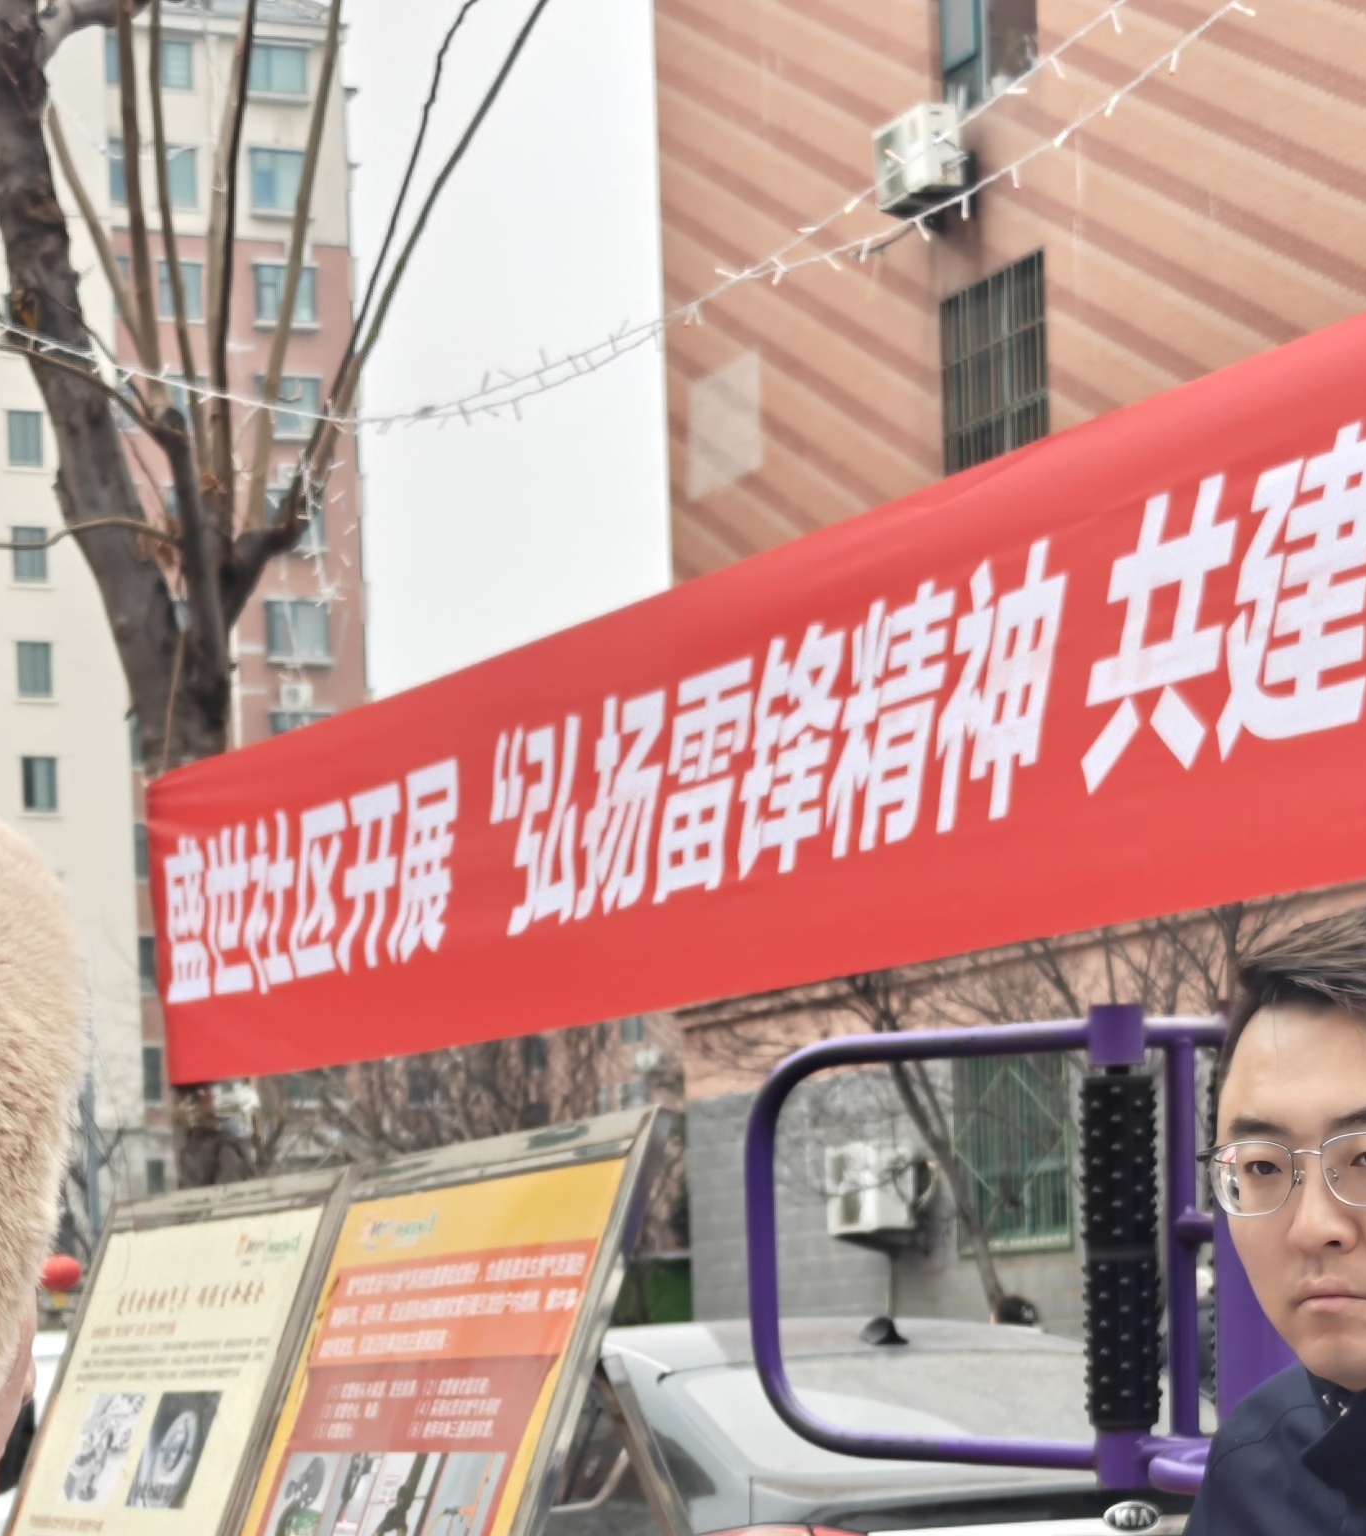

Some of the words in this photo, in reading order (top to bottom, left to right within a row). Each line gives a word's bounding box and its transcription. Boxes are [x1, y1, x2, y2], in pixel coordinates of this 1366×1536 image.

[164, 757, 459, 1003] 盛世社区开展
[490, 537, 1067, 935] “弘扬雷锋精神
[1114, 1507, 1153, 1528] KIA
